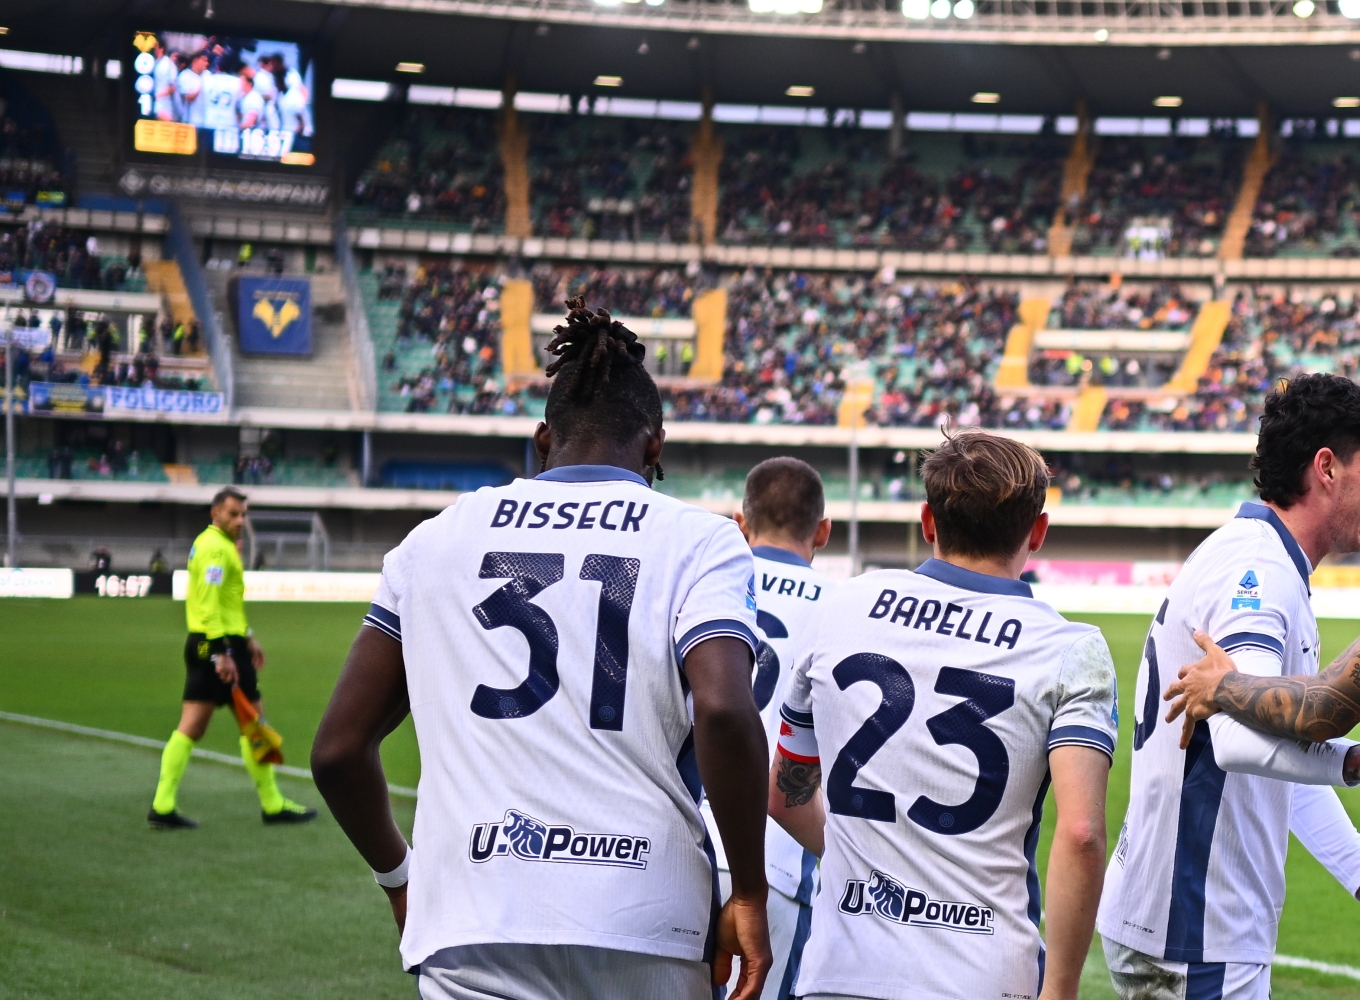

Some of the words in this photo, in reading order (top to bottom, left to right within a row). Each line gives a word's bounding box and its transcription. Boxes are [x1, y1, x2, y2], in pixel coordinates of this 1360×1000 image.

[491, 499, 649, 532] BISSECK
[96, 575, 152, 598] 16:57
[762, 573, 822, 601] VRIJ
[471, 551, 641, 732] 31
[868, 588, 1023, 650] BARELLA
[826, 652, 1016, 836] 23
